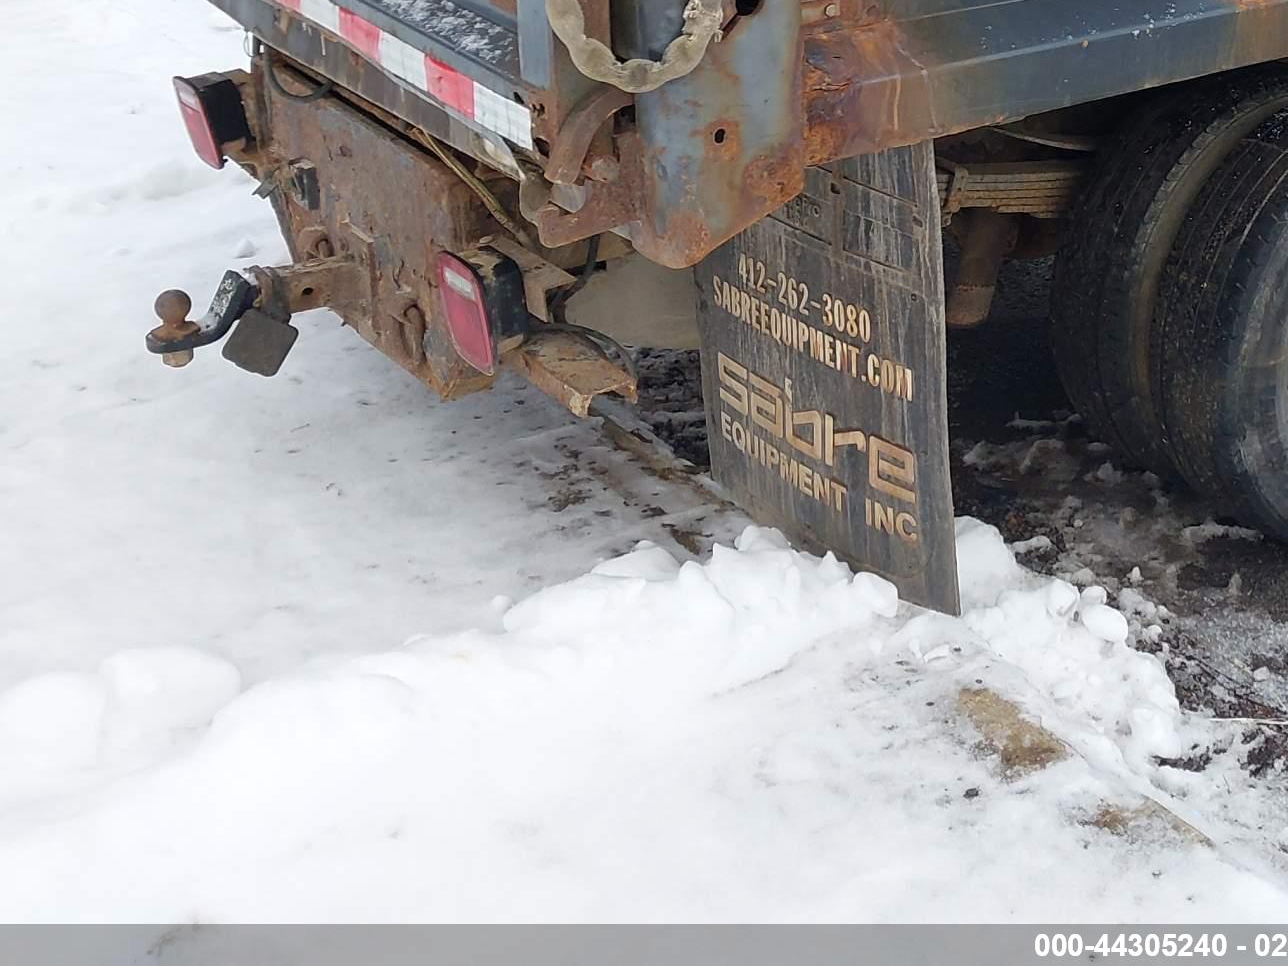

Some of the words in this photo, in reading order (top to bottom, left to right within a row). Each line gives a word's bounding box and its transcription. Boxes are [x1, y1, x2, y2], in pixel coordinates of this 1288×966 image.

[712, 275, 913, 402] SABREEQUIPMENT.COM
[738, 252, 871, 343] 412-262-3080
[720, 411, 848, 513] EQUIPMENT
[864, 497, 918, 542] INC
